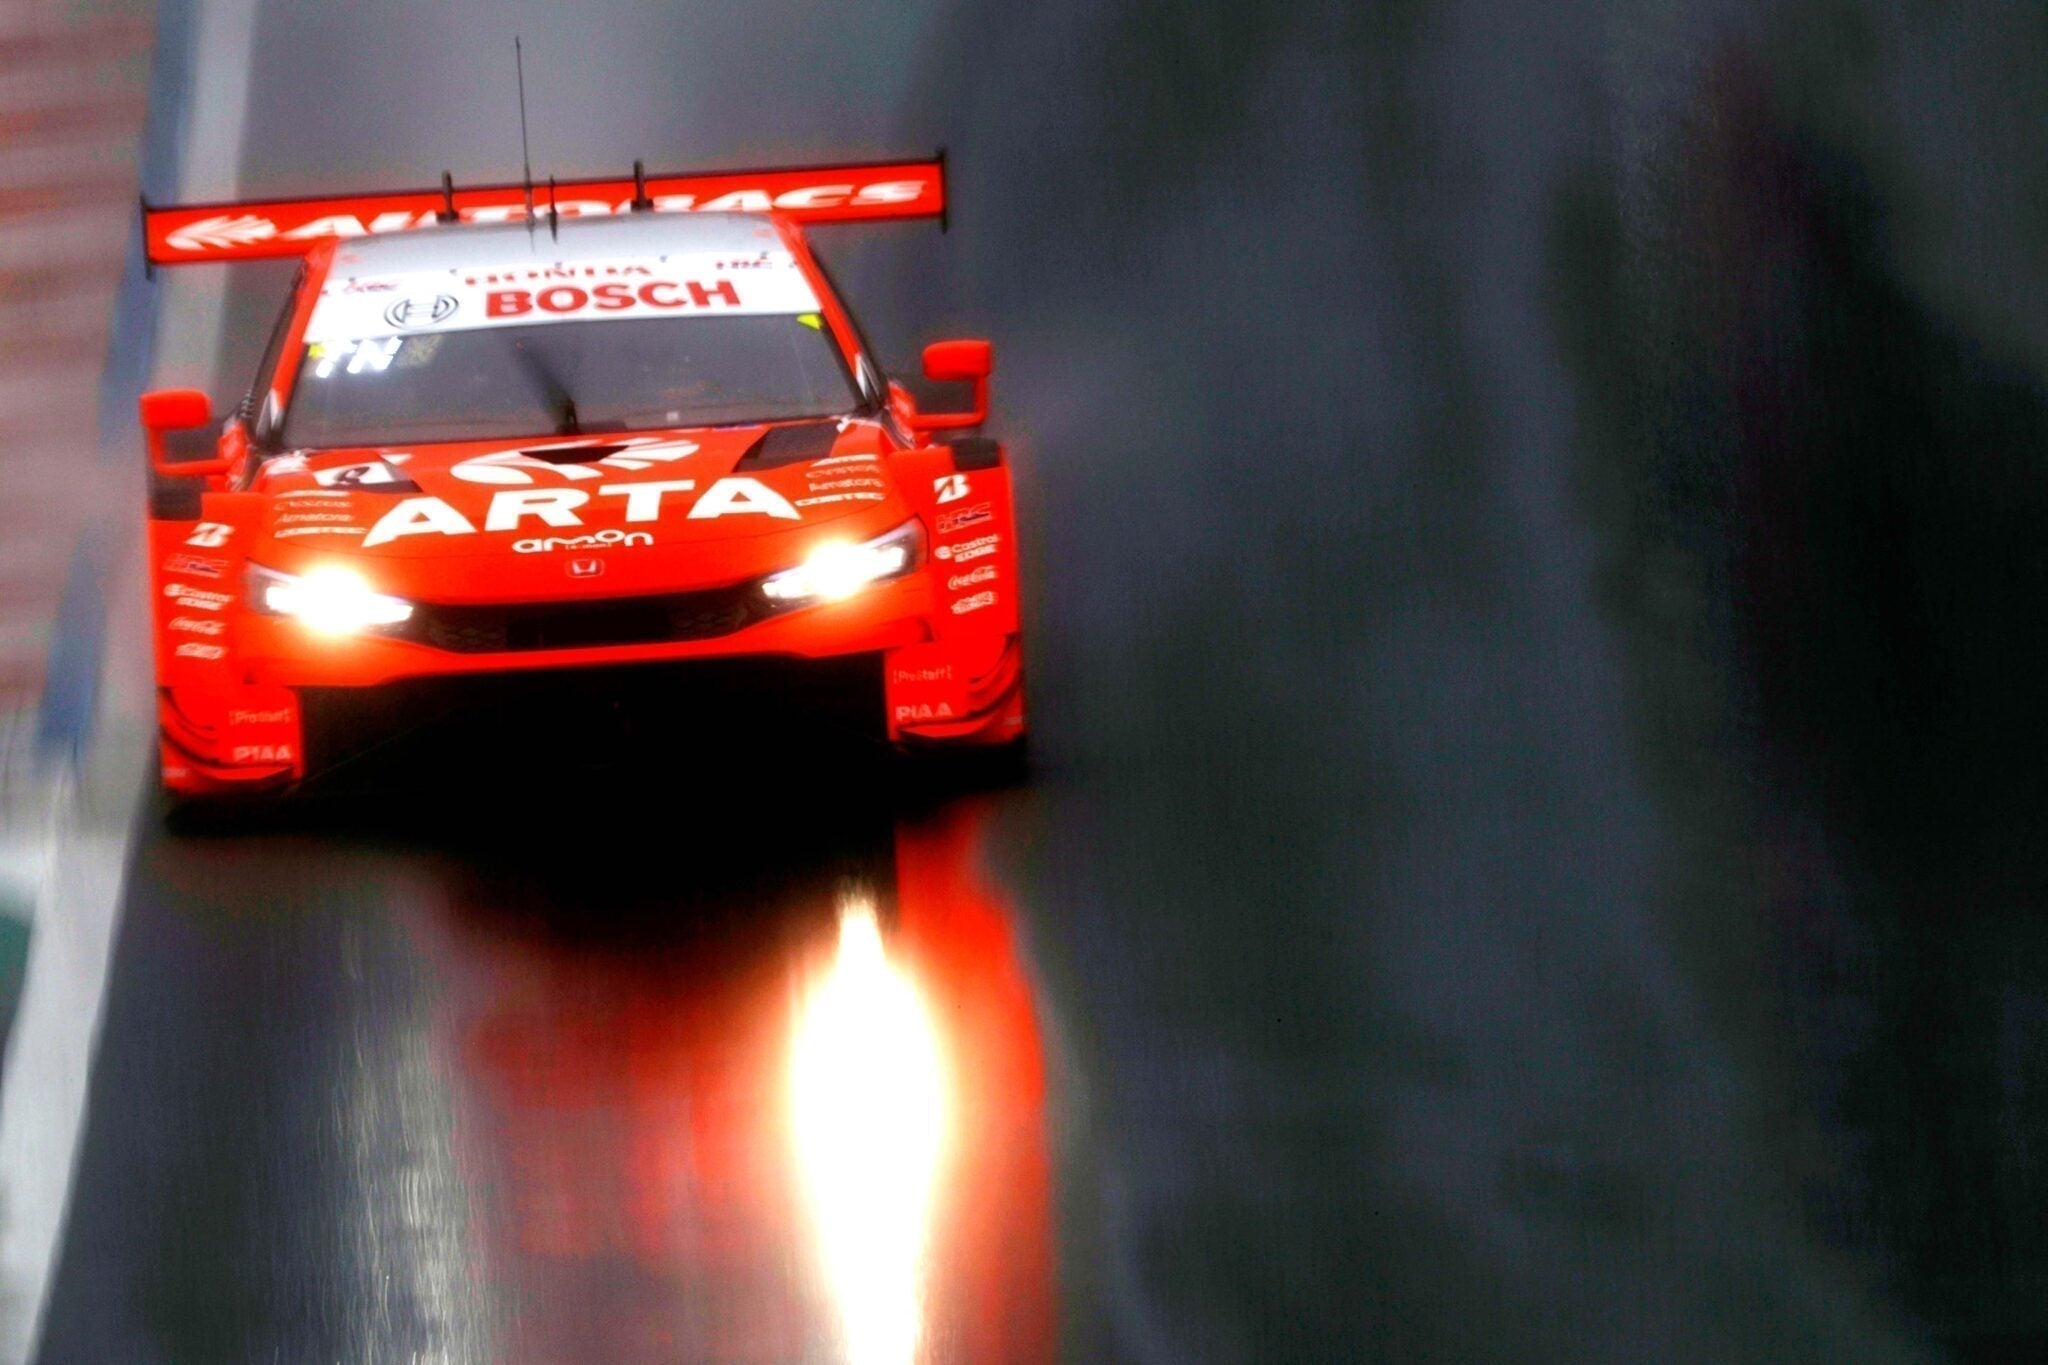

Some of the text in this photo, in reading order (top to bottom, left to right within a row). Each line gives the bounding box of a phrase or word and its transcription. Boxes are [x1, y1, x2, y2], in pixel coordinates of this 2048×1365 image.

[486, 281, 740, 319] BOSCH
[361, 476, 802, 547] ARTA
[512, 529, 654, 553] amon
[895, 702, 953, 721] PIAA
[233, 745, 291, 762] PIAA
